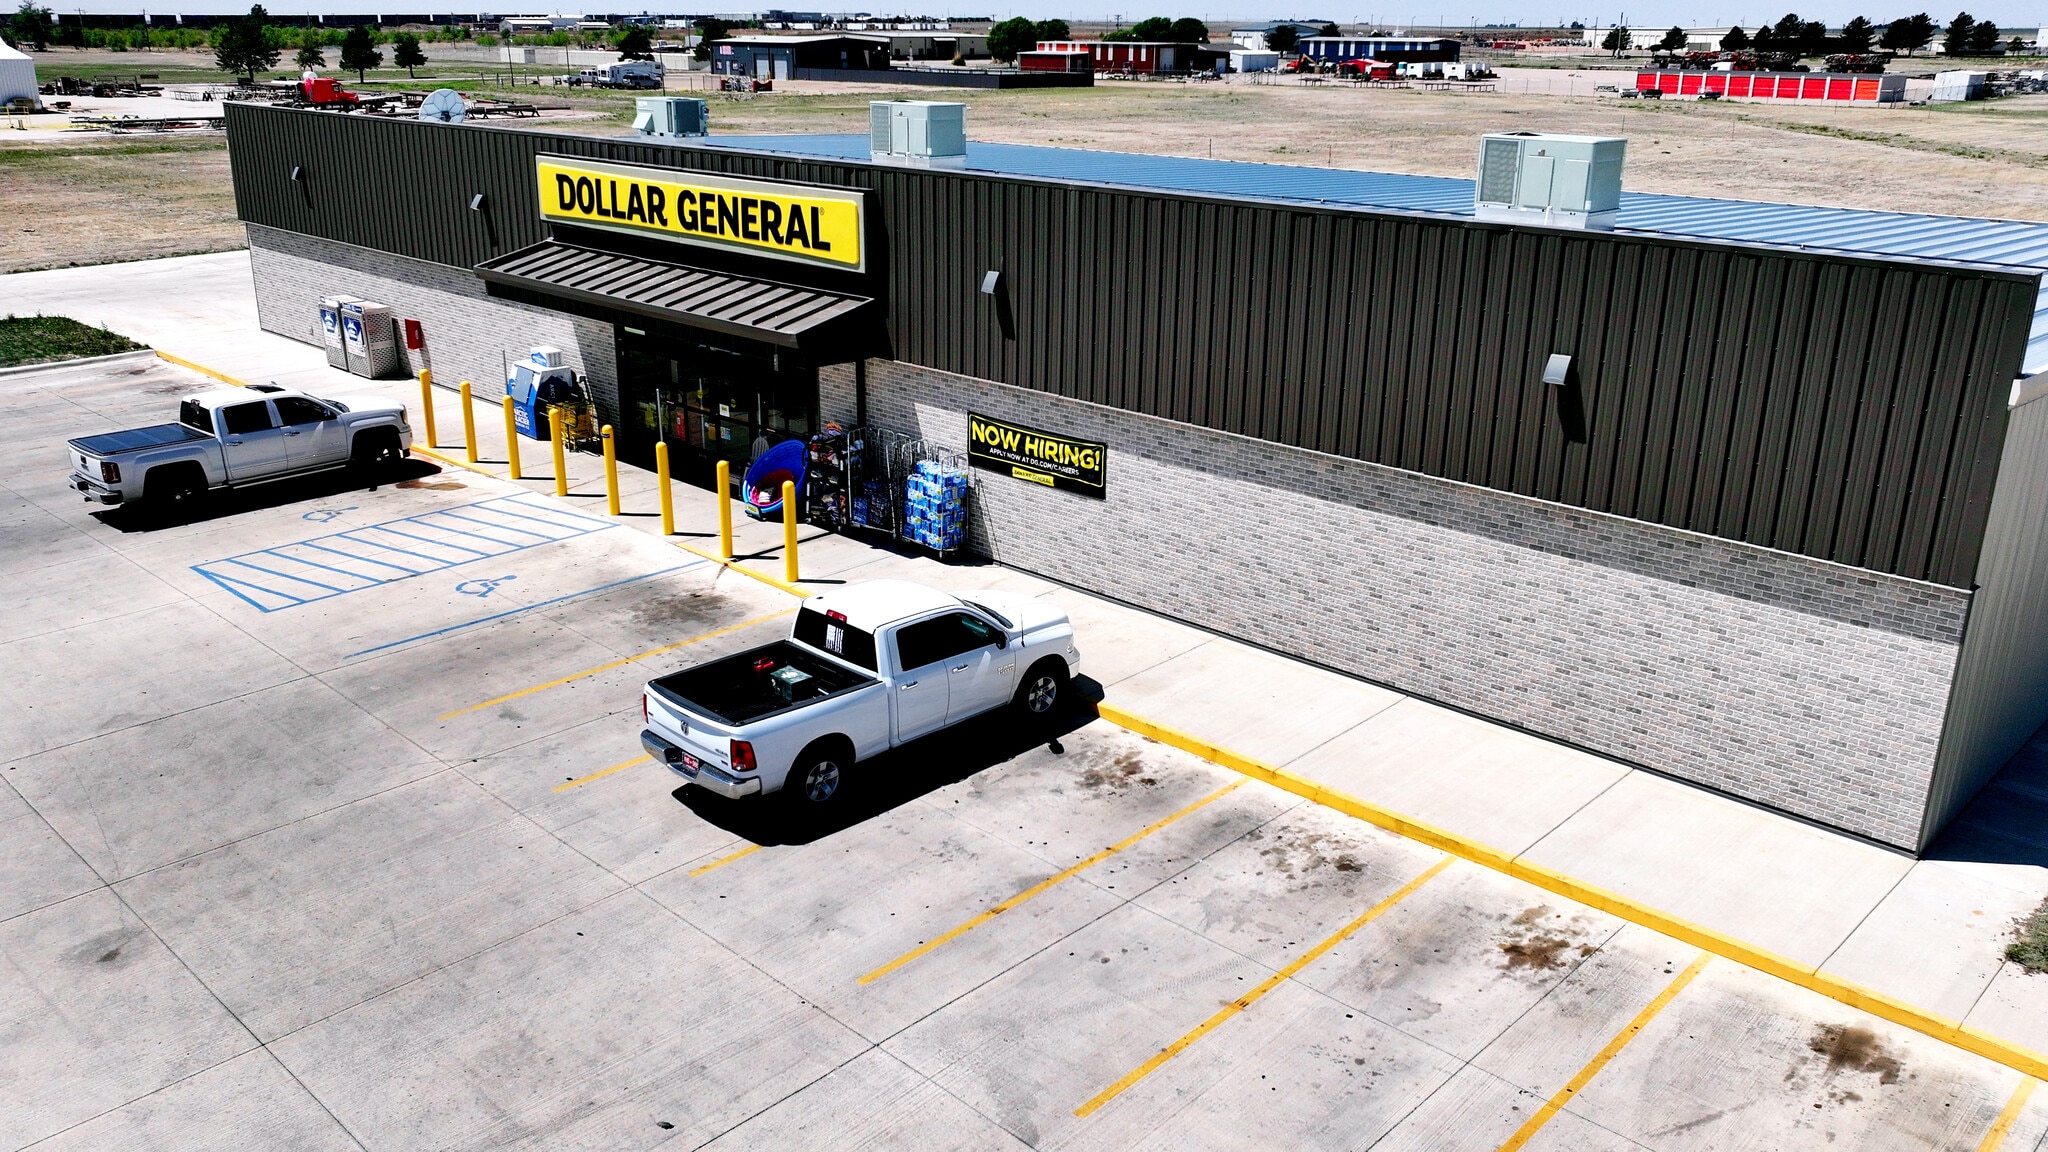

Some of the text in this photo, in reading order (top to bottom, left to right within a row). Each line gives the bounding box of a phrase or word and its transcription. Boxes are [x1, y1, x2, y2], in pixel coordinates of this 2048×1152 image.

[556, 173, 667, 226] DOLLAR
[972, 420, 1100, 471] NOW HIRING!
[989, 447, 1080, 476] APPLY NOW AT DG.COM/CAREERS
